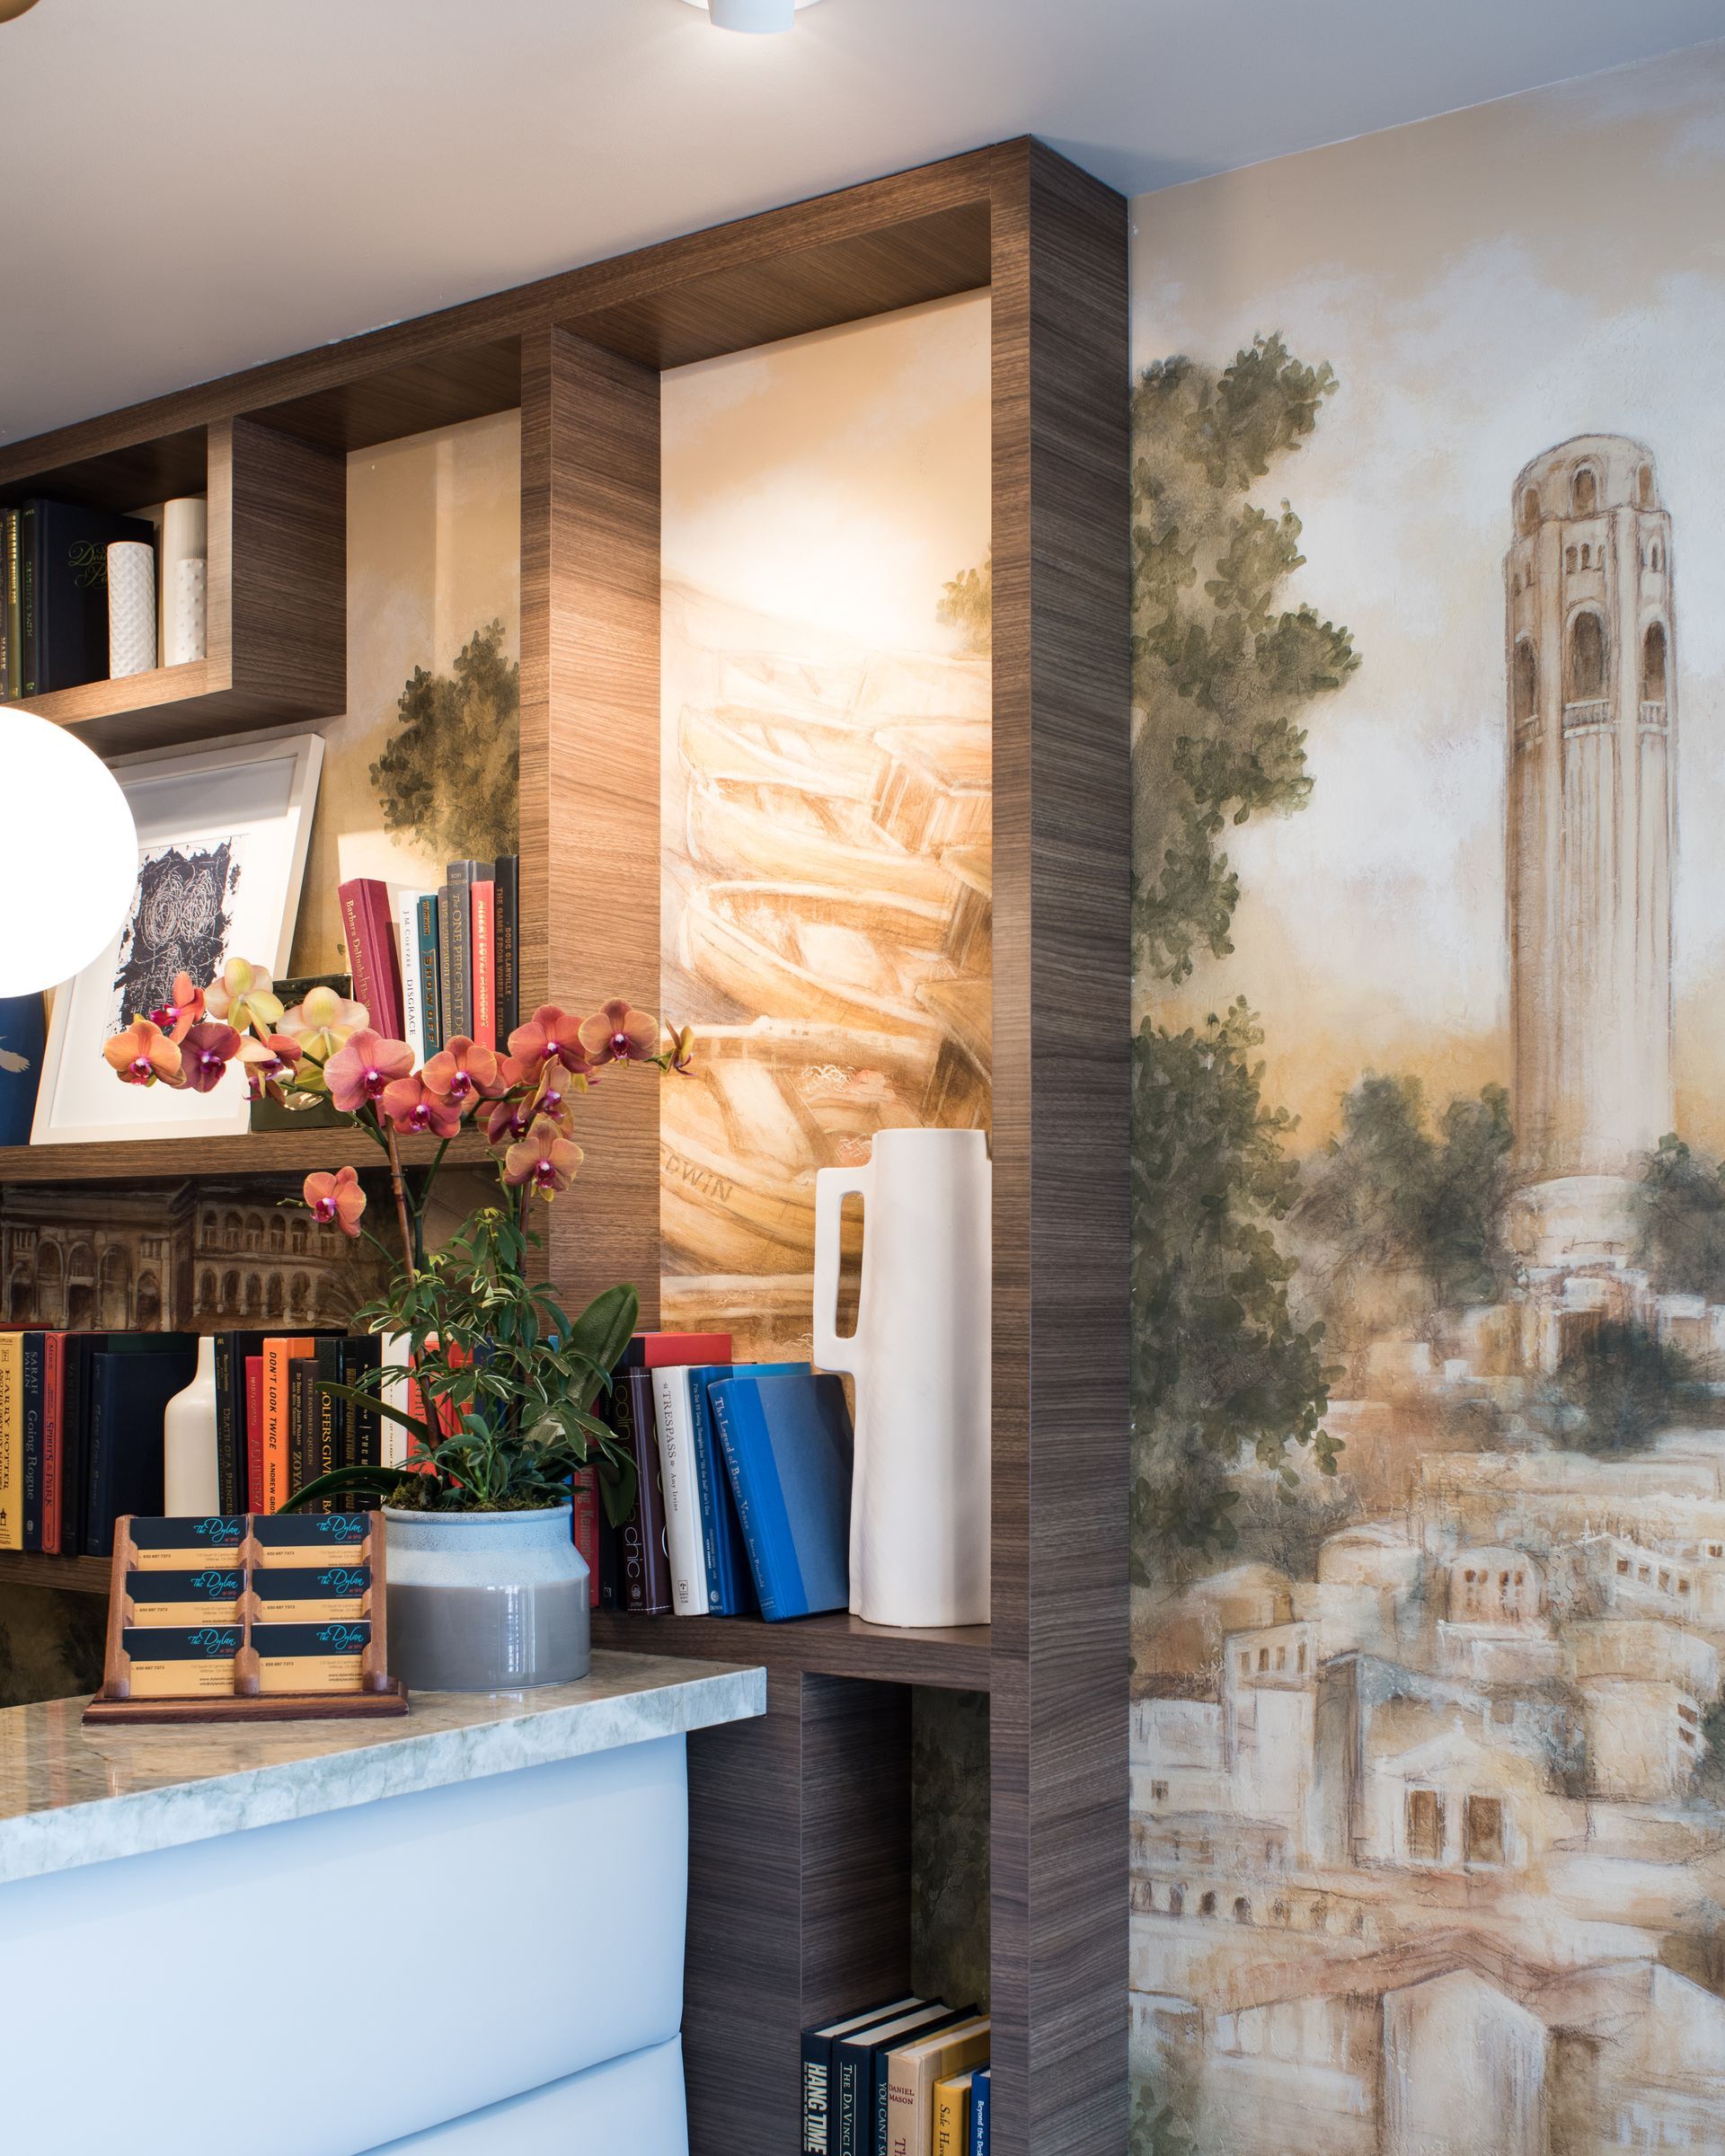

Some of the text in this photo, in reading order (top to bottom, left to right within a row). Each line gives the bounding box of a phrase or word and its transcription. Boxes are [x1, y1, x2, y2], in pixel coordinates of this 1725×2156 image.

[453, 910, 462, 942] ONE
[478, 901, 486, 940] MISERY
[346, 900, 357, 936] Barbara
[353, 938, 364, 977] Delinsky
[479, 942, 487, 975] LOVES
[454, 945, 463, 1012] PERCENT
[407, 979, 416, 1035] DISGRACE
[455, 1015, 463, 1036] DO
[346, 1400, 356, 1459] NFORMATION
[663, 1391, 676, 1458] TRESPASS
[25, 1410, 37, 1500] Going Rogue
[225, 1445, 230, 1459] OF
[714, 1397, 749, 1530] The Legend of Bagger Vance
[252, 1439, 261, 1507] ADULTERY
[323, 1500, 332, 1515] BA
[194, 1518, 240, 1542] The Dylan
[317, 1515, 363, 1541] The Dylan
[625, 1527, 643, 1577] chic
[191, 1571, 238, 1596] The Dylan
[318, 1568, 364, 1594] The Dylan
[189, 1629, 235, 1654] The Dylan
[317, 1624, 364, 1649] The Dylan
[844, 2064, 852, 2145] THE DA VINCI
[879, 2082, 887, 2105] YOU
[889, 2085, 915, 2096] DANIEL
[889, 2094, 913, 2105] MASON
[808, 2063, 827, 2155] HANG TIME
[940, 2104, 950, 2126] Safe
